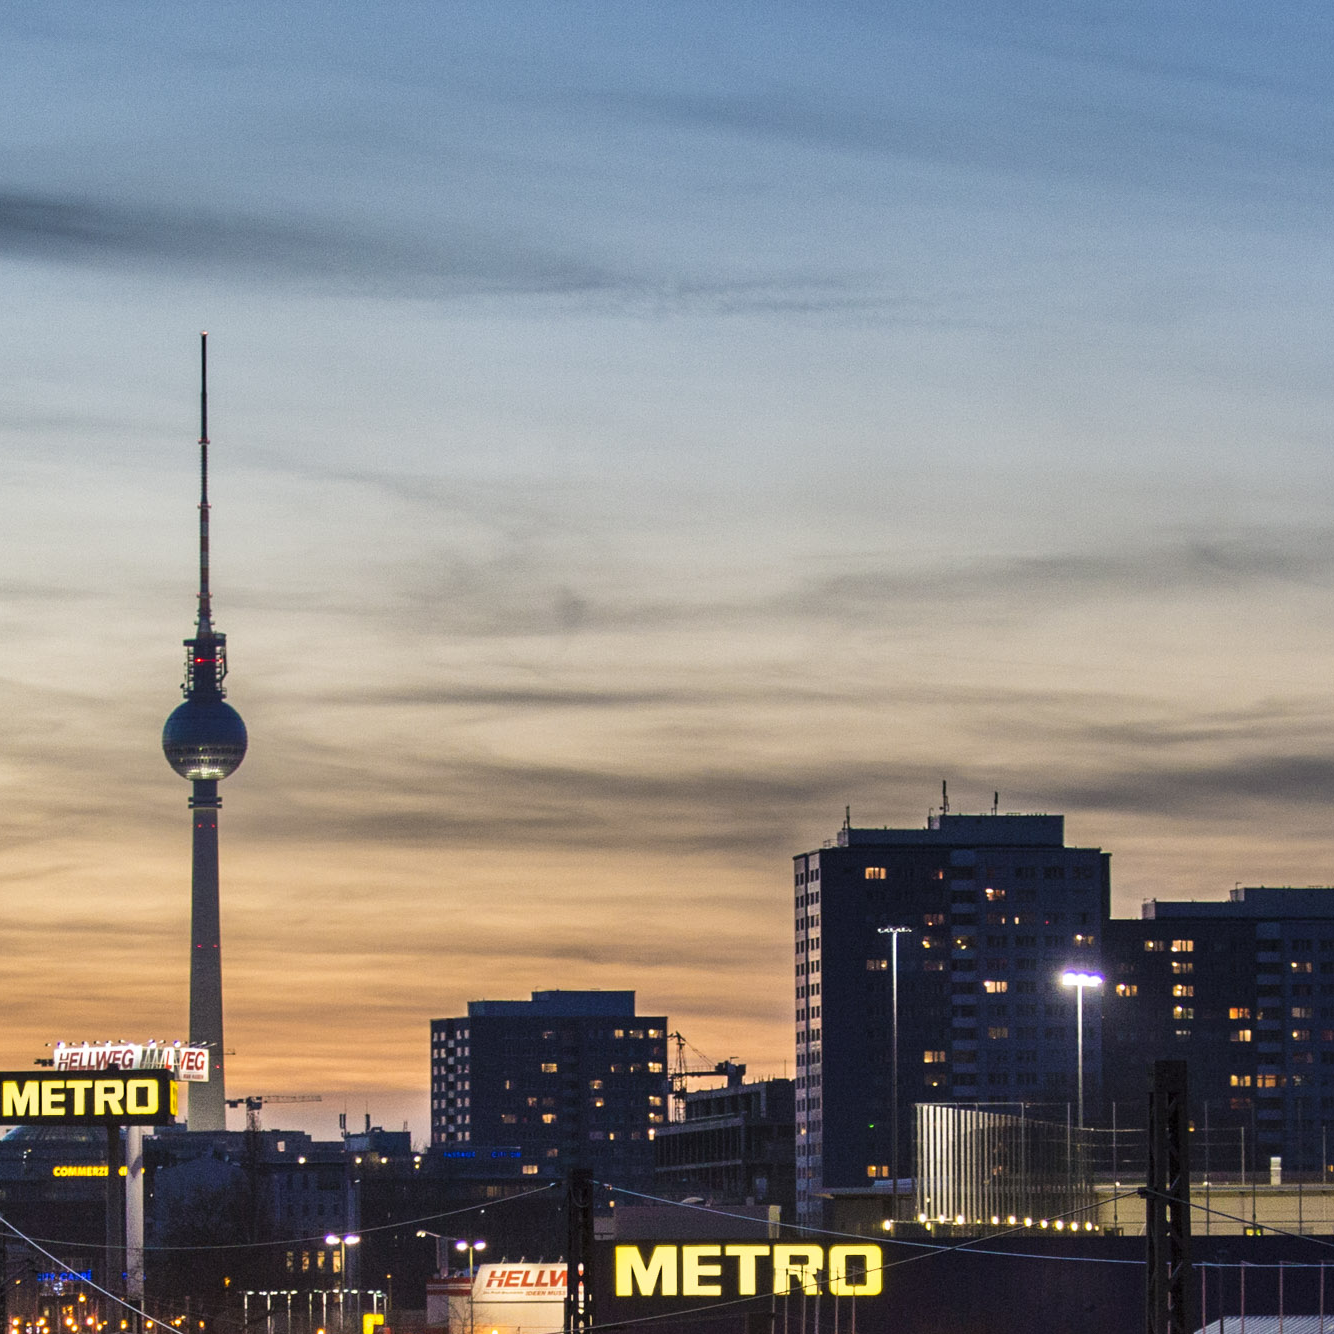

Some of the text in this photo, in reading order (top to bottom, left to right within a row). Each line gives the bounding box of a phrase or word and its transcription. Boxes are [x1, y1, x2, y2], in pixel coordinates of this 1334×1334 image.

[58, 1049, 134, 1071] HELLWEG
[2, 1078, 159, 1117] METRO
[486, 1270, 568, 1287] HELLW
[615, 1244, 883, 1296] METRO
